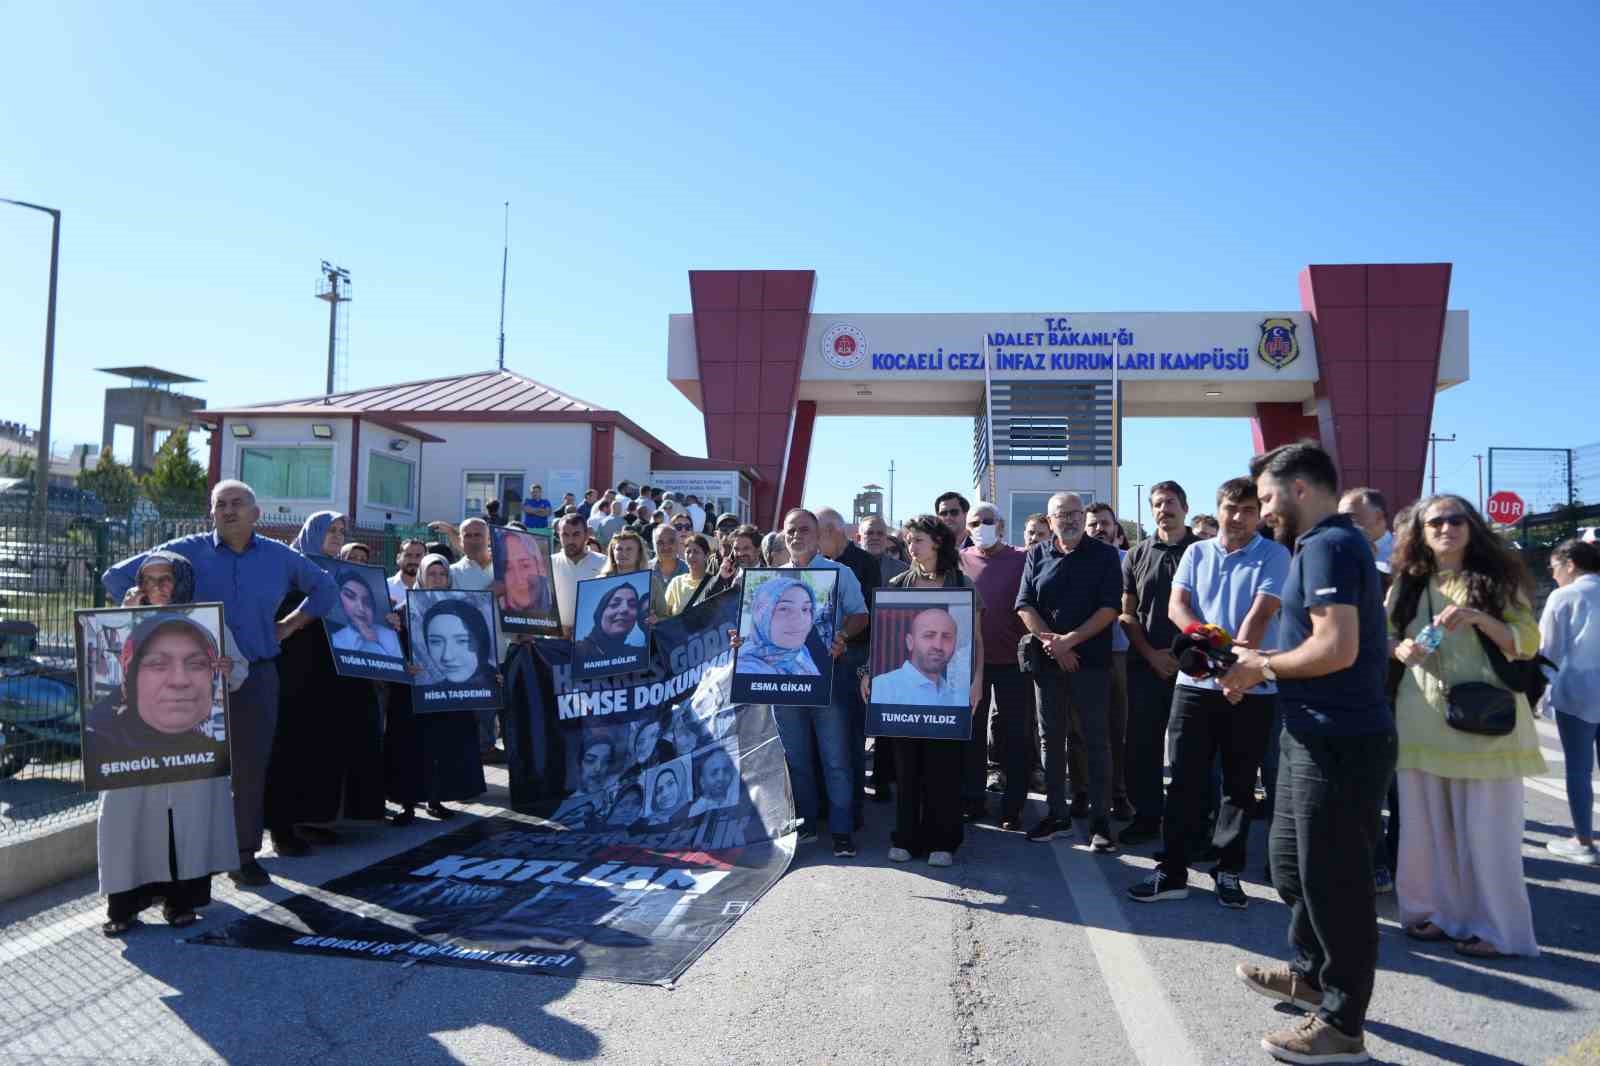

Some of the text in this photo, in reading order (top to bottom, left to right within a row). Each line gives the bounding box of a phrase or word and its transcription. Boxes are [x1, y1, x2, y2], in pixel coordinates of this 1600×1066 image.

[1046, 318, 1072, 332] T.C.
[987, 332, 1044, 346] ADALET
[872, 347, 1249, 370] KOCAELİ CEZA İNFAZ KURUMLARI KAMPÜSÜ
[1489, 500, 1521, 516] DUR
[750, 680, 812, 692] ESMA GİKAN
[448, 687, 492, 701] TAŞDEMİR
[557, 688, 628, 720] KİMSE
[881, 712, 956, 724] TUNCAY YILDIZ
[101, 751, 216, 776] ŞENGÜL YILMAZ
[409, 855, 731, 894] KATLİAM
